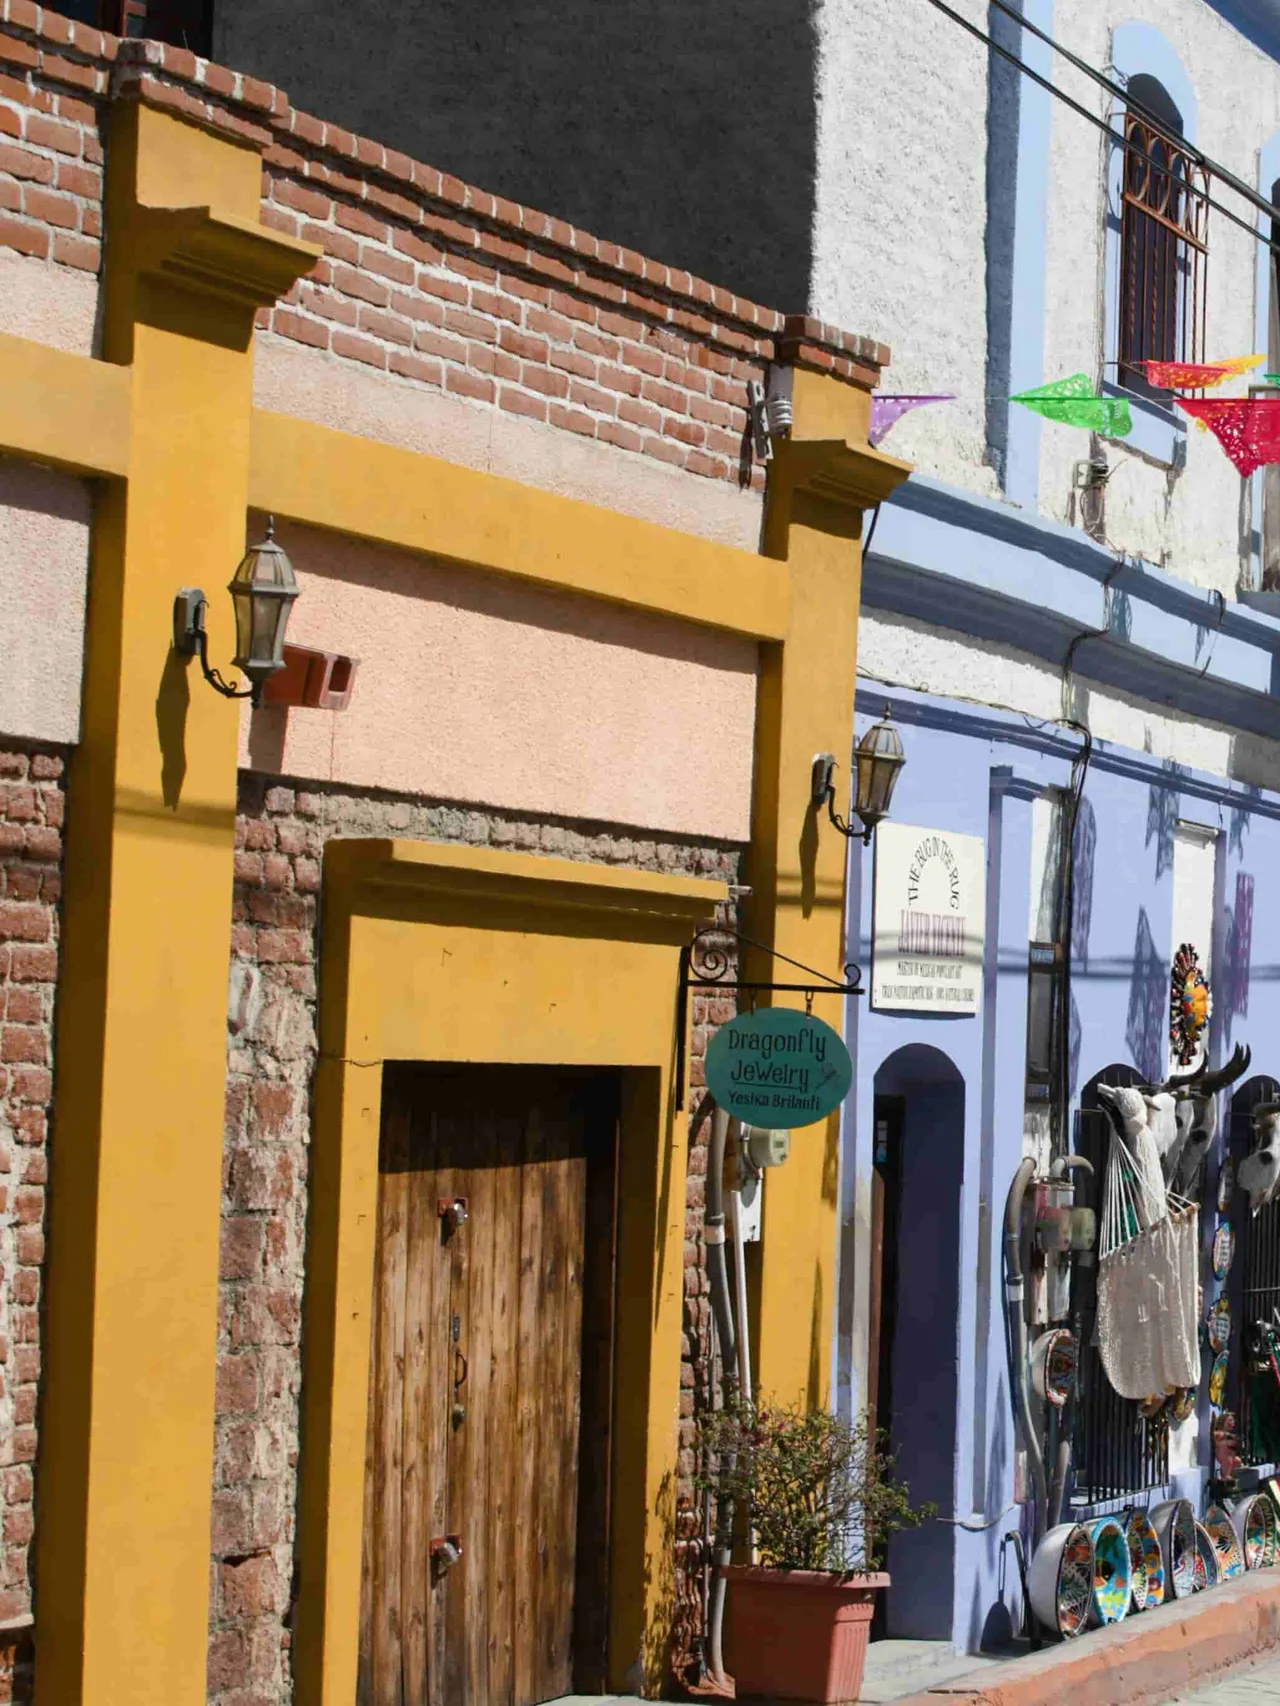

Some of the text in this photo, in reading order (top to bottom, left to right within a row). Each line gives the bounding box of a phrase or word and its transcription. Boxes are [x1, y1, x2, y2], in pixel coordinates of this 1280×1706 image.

[908, 863, 921, 906] THE
[949, 867, 960, 910] RUG
[728, 1028, 827, 1062] Dragonfly
[729, 1091, 769, 1106] Yesika
